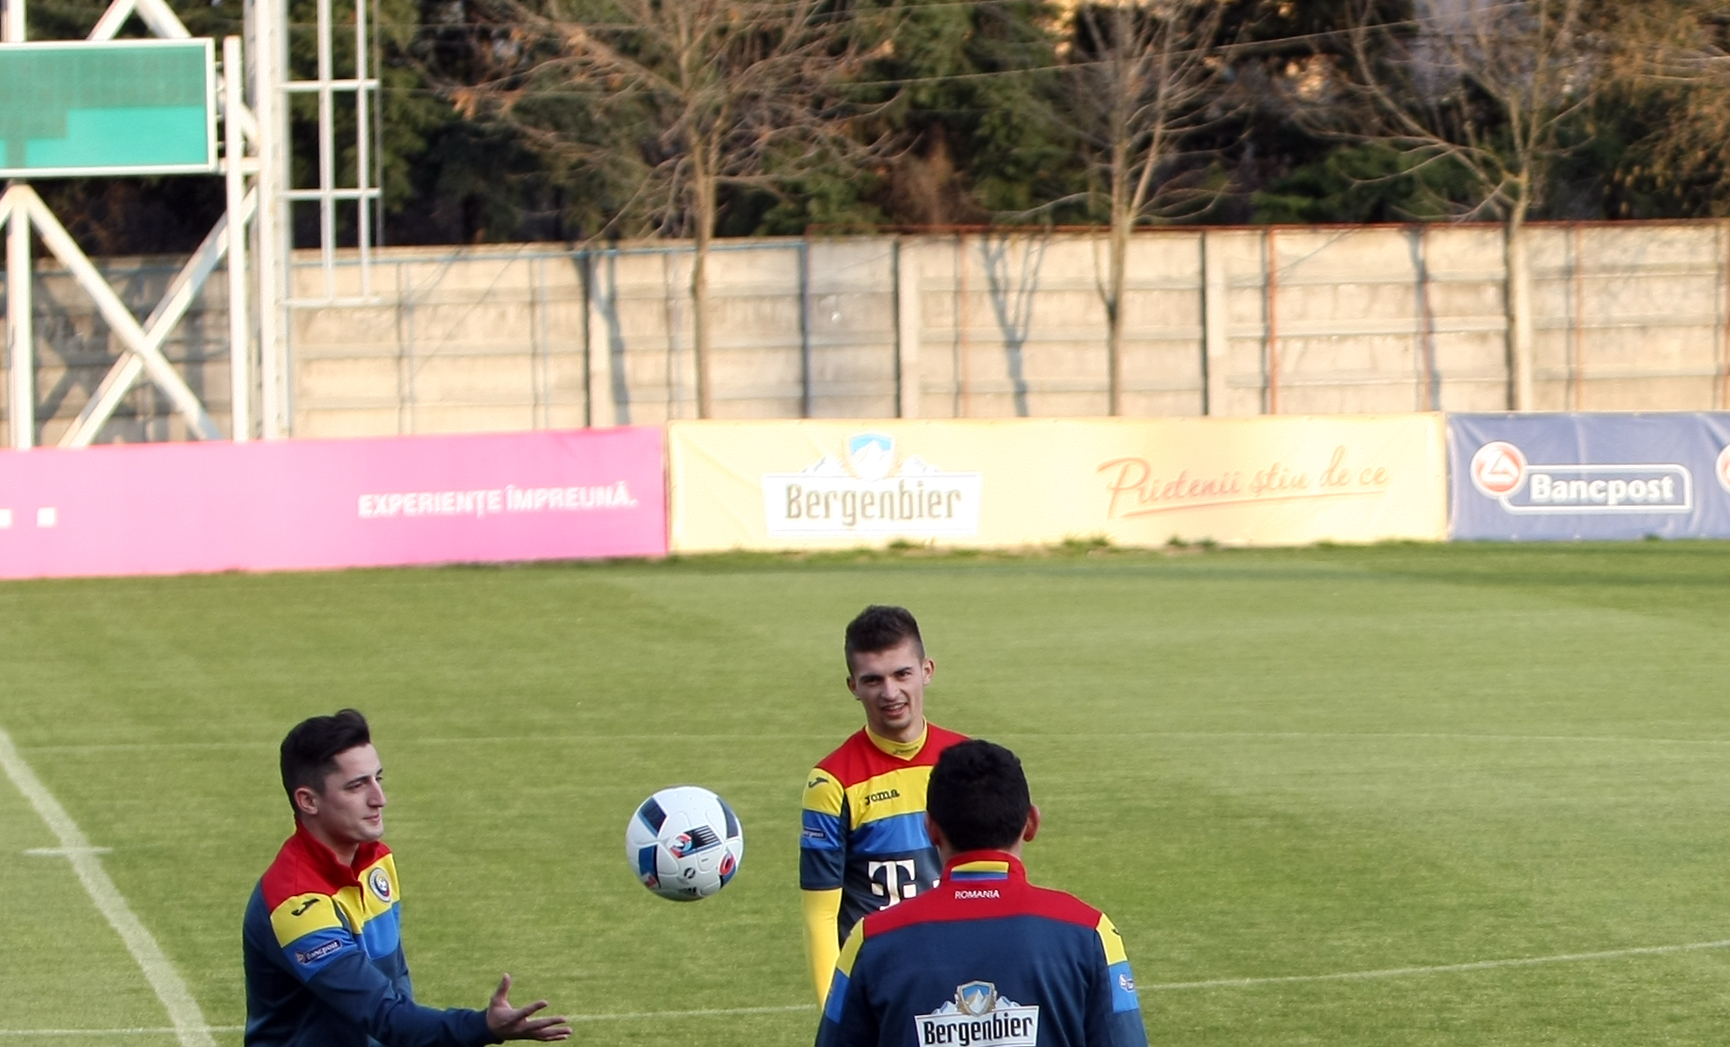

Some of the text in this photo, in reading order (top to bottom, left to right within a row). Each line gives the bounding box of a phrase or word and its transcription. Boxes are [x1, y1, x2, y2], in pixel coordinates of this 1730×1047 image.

[1320, 445, 1352, 487] de
[1360, 465, 1388, 486] ce
[785, 479, 962, 527] Bergenbier
[1529, 474, 1675, 504] Bancpost
[954, 889, 1000, 900] ROMANIA
[922, 1011, 1034, 1047] Bergenbier
